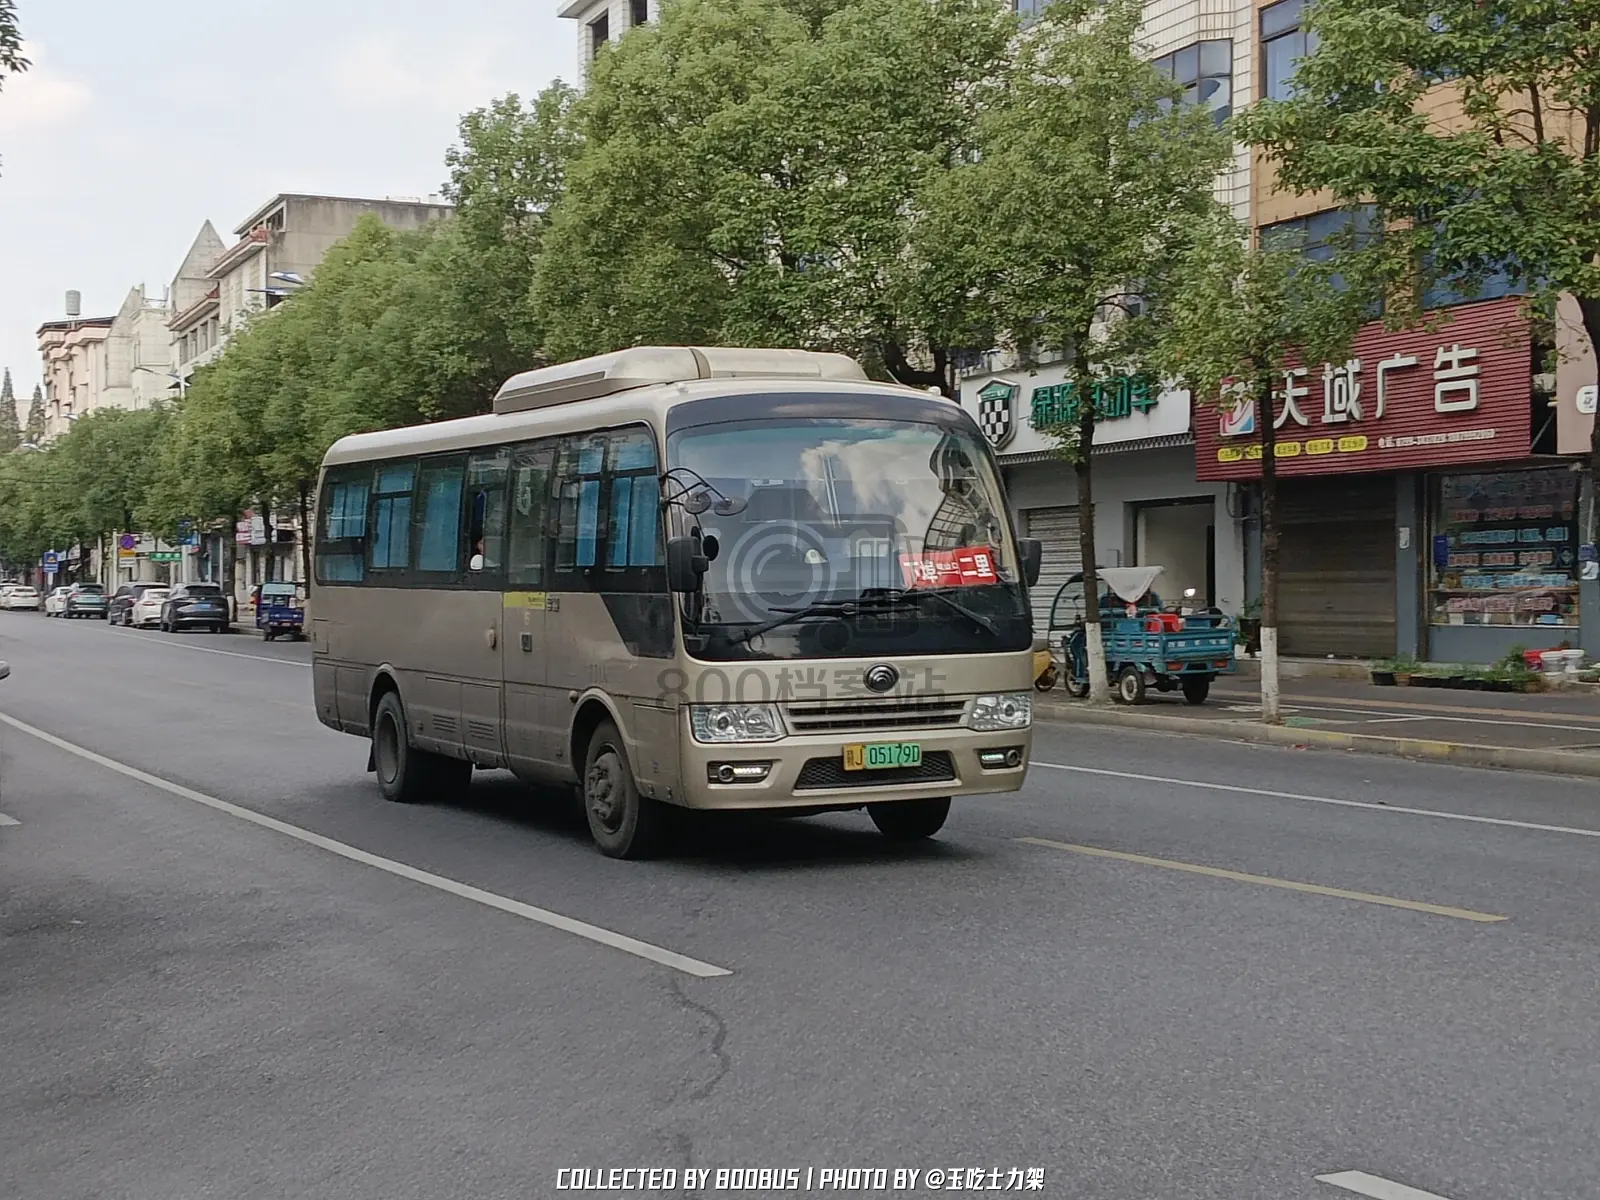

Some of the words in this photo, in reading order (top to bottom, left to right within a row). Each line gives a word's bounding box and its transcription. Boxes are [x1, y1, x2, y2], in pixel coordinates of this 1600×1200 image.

[1272, 343, 1481, 430] 天域广告
[959, 554, 993, 577] 二里
[869, 745, 920, 765] 05179D
